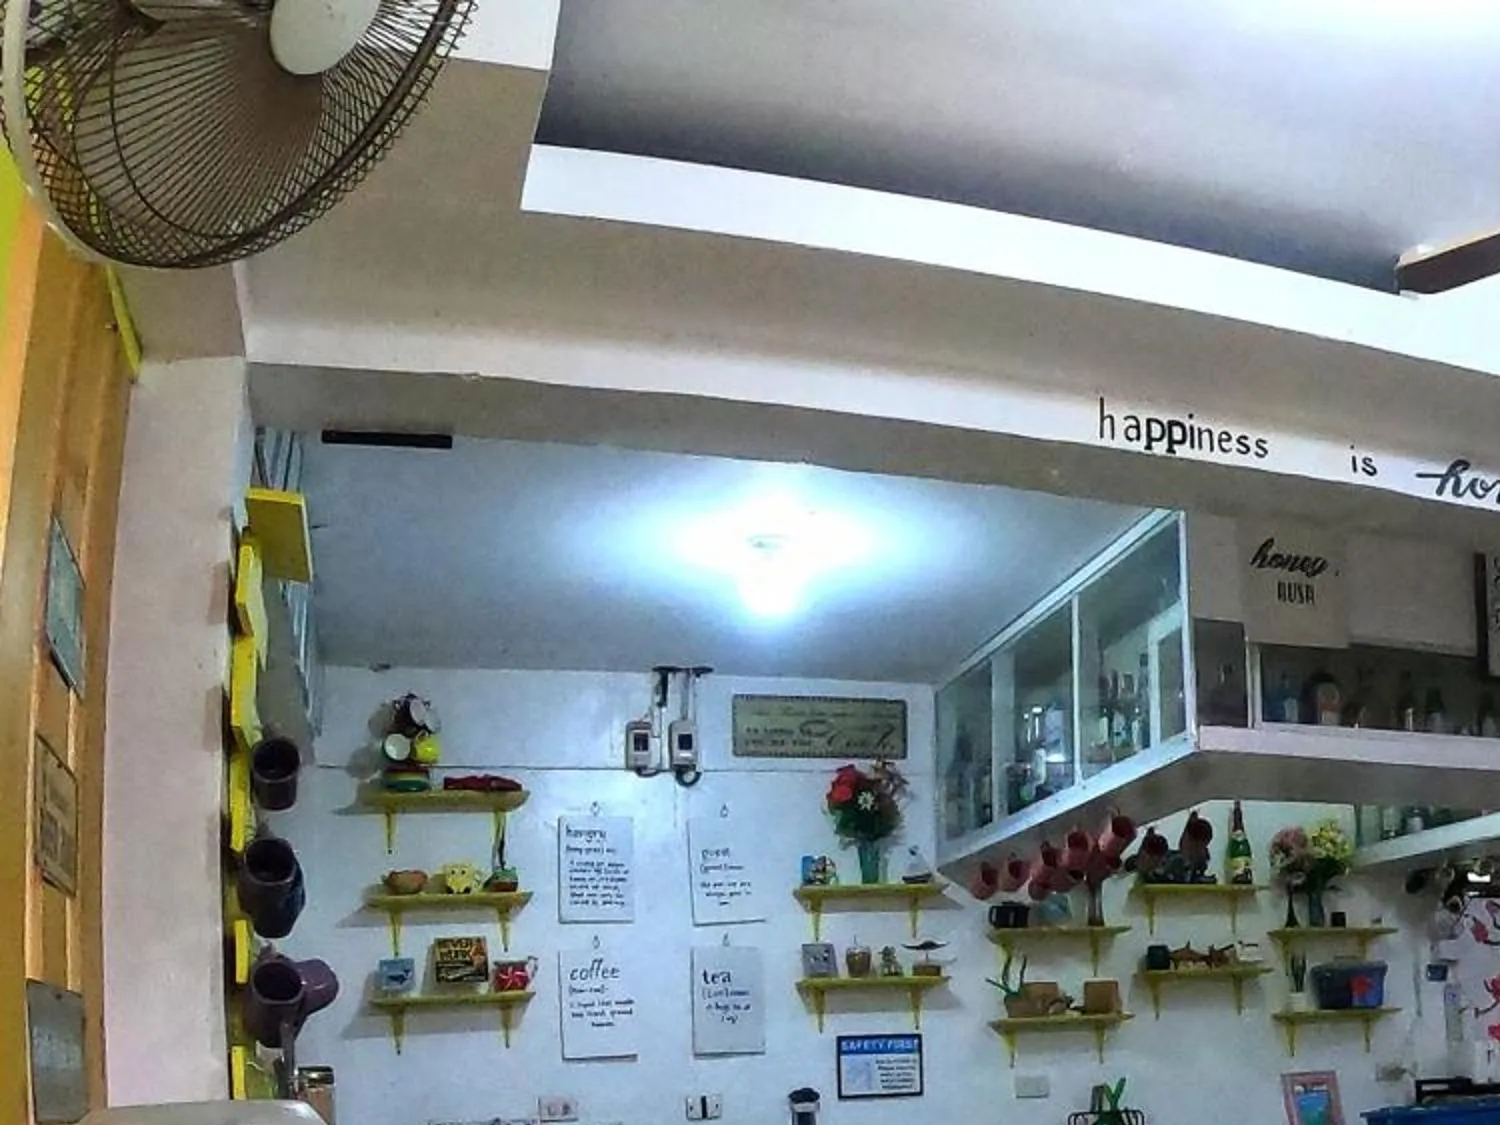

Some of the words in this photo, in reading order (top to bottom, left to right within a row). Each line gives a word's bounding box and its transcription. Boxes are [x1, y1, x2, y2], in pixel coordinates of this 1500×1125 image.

[1099, 398, 1269, 459] happiness
[1350, 444, 1378, 477] is
[569, 957, 621, 981] coffee
[702, 969, 731, 985] tea
